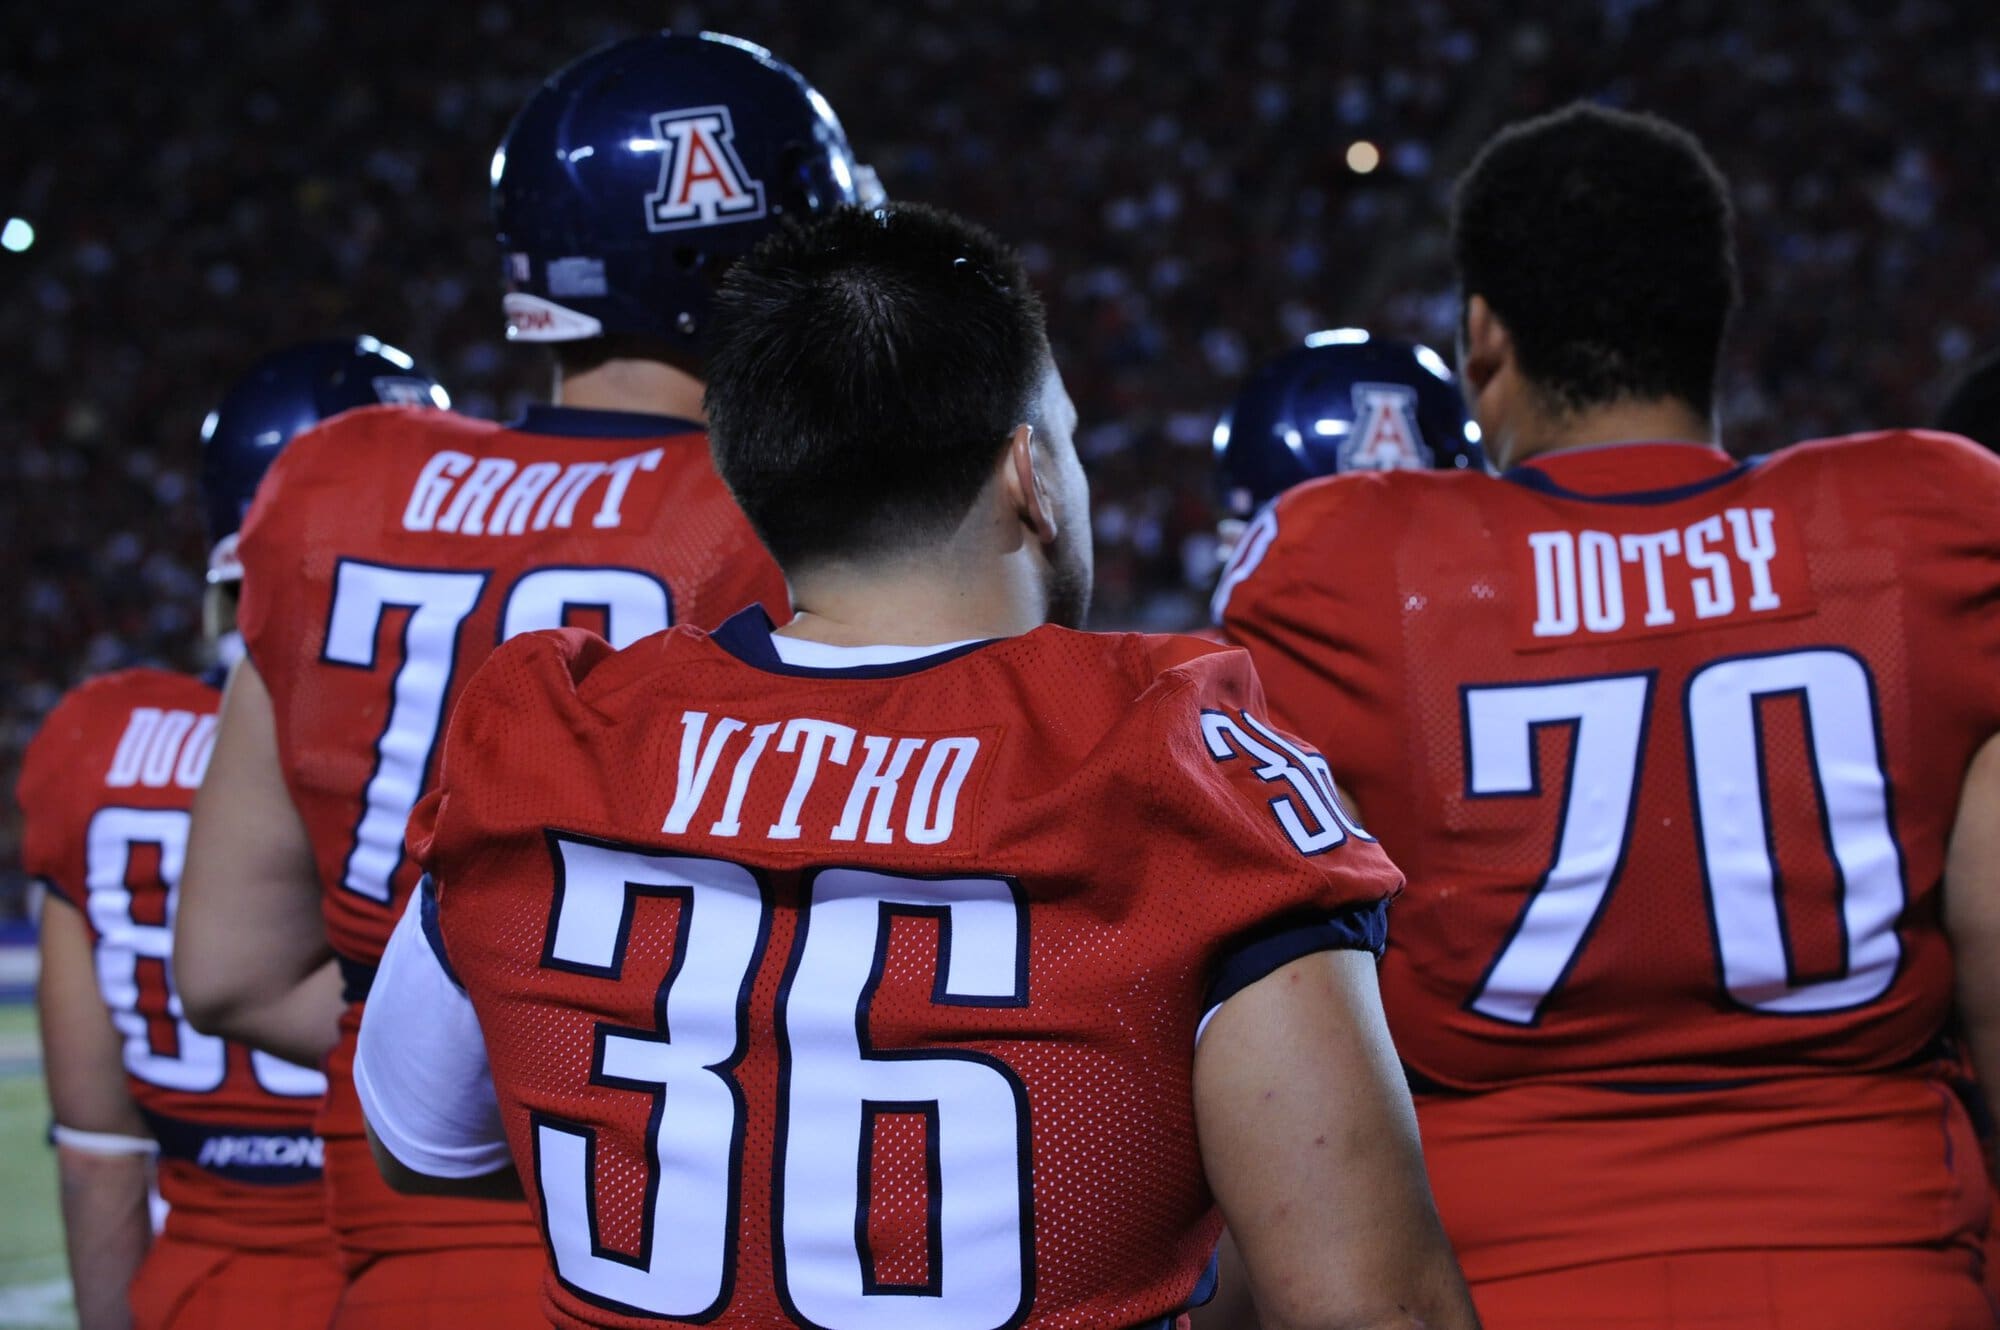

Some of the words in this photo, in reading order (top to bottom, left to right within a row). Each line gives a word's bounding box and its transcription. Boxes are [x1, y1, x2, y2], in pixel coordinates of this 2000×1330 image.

[644, 105, 766, 233] A
[402, 447, 664, 536] GRANT
[1528, 507, 1780, 637] DOTSY
[661, 711, 980, 845] VITKO
[1459, 645, 1906, 1028] 70
[531, 827, 1036, 1330] 36
